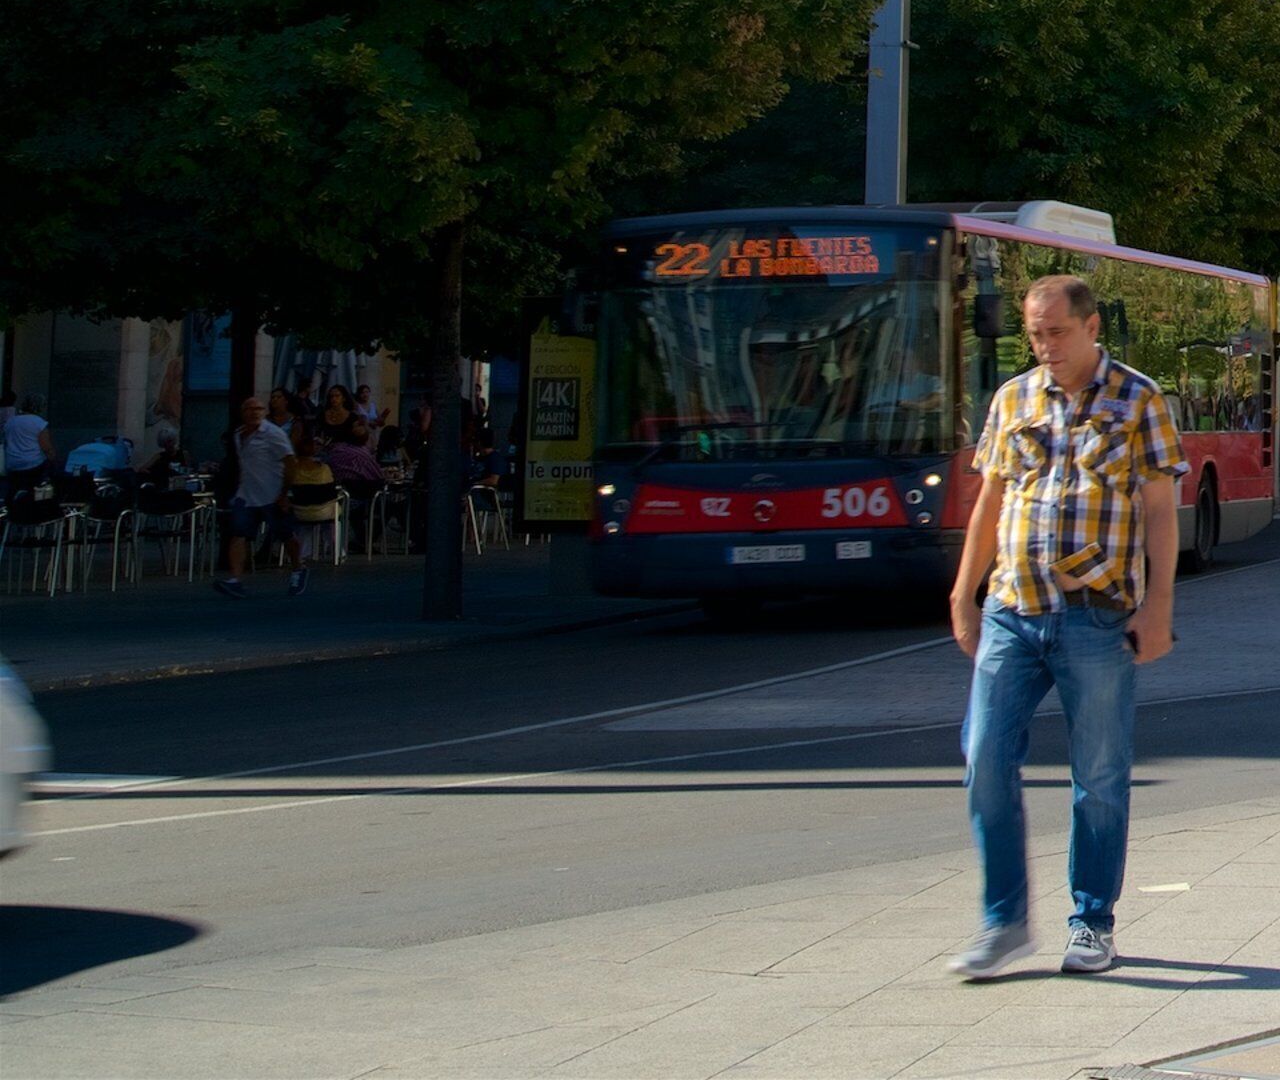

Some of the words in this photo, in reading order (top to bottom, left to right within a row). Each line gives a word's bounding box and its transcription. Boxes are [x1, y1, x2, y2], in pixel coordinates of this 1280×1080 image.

[655, 242, 711, 276] 22
[729, 239, 771, 257] LAS
[776, 236, 872, 257] FUENTES
[720, 257, 751, 277] LA
[528, 461, 545, 479] Te
[821, 486, 891, 518] 506
